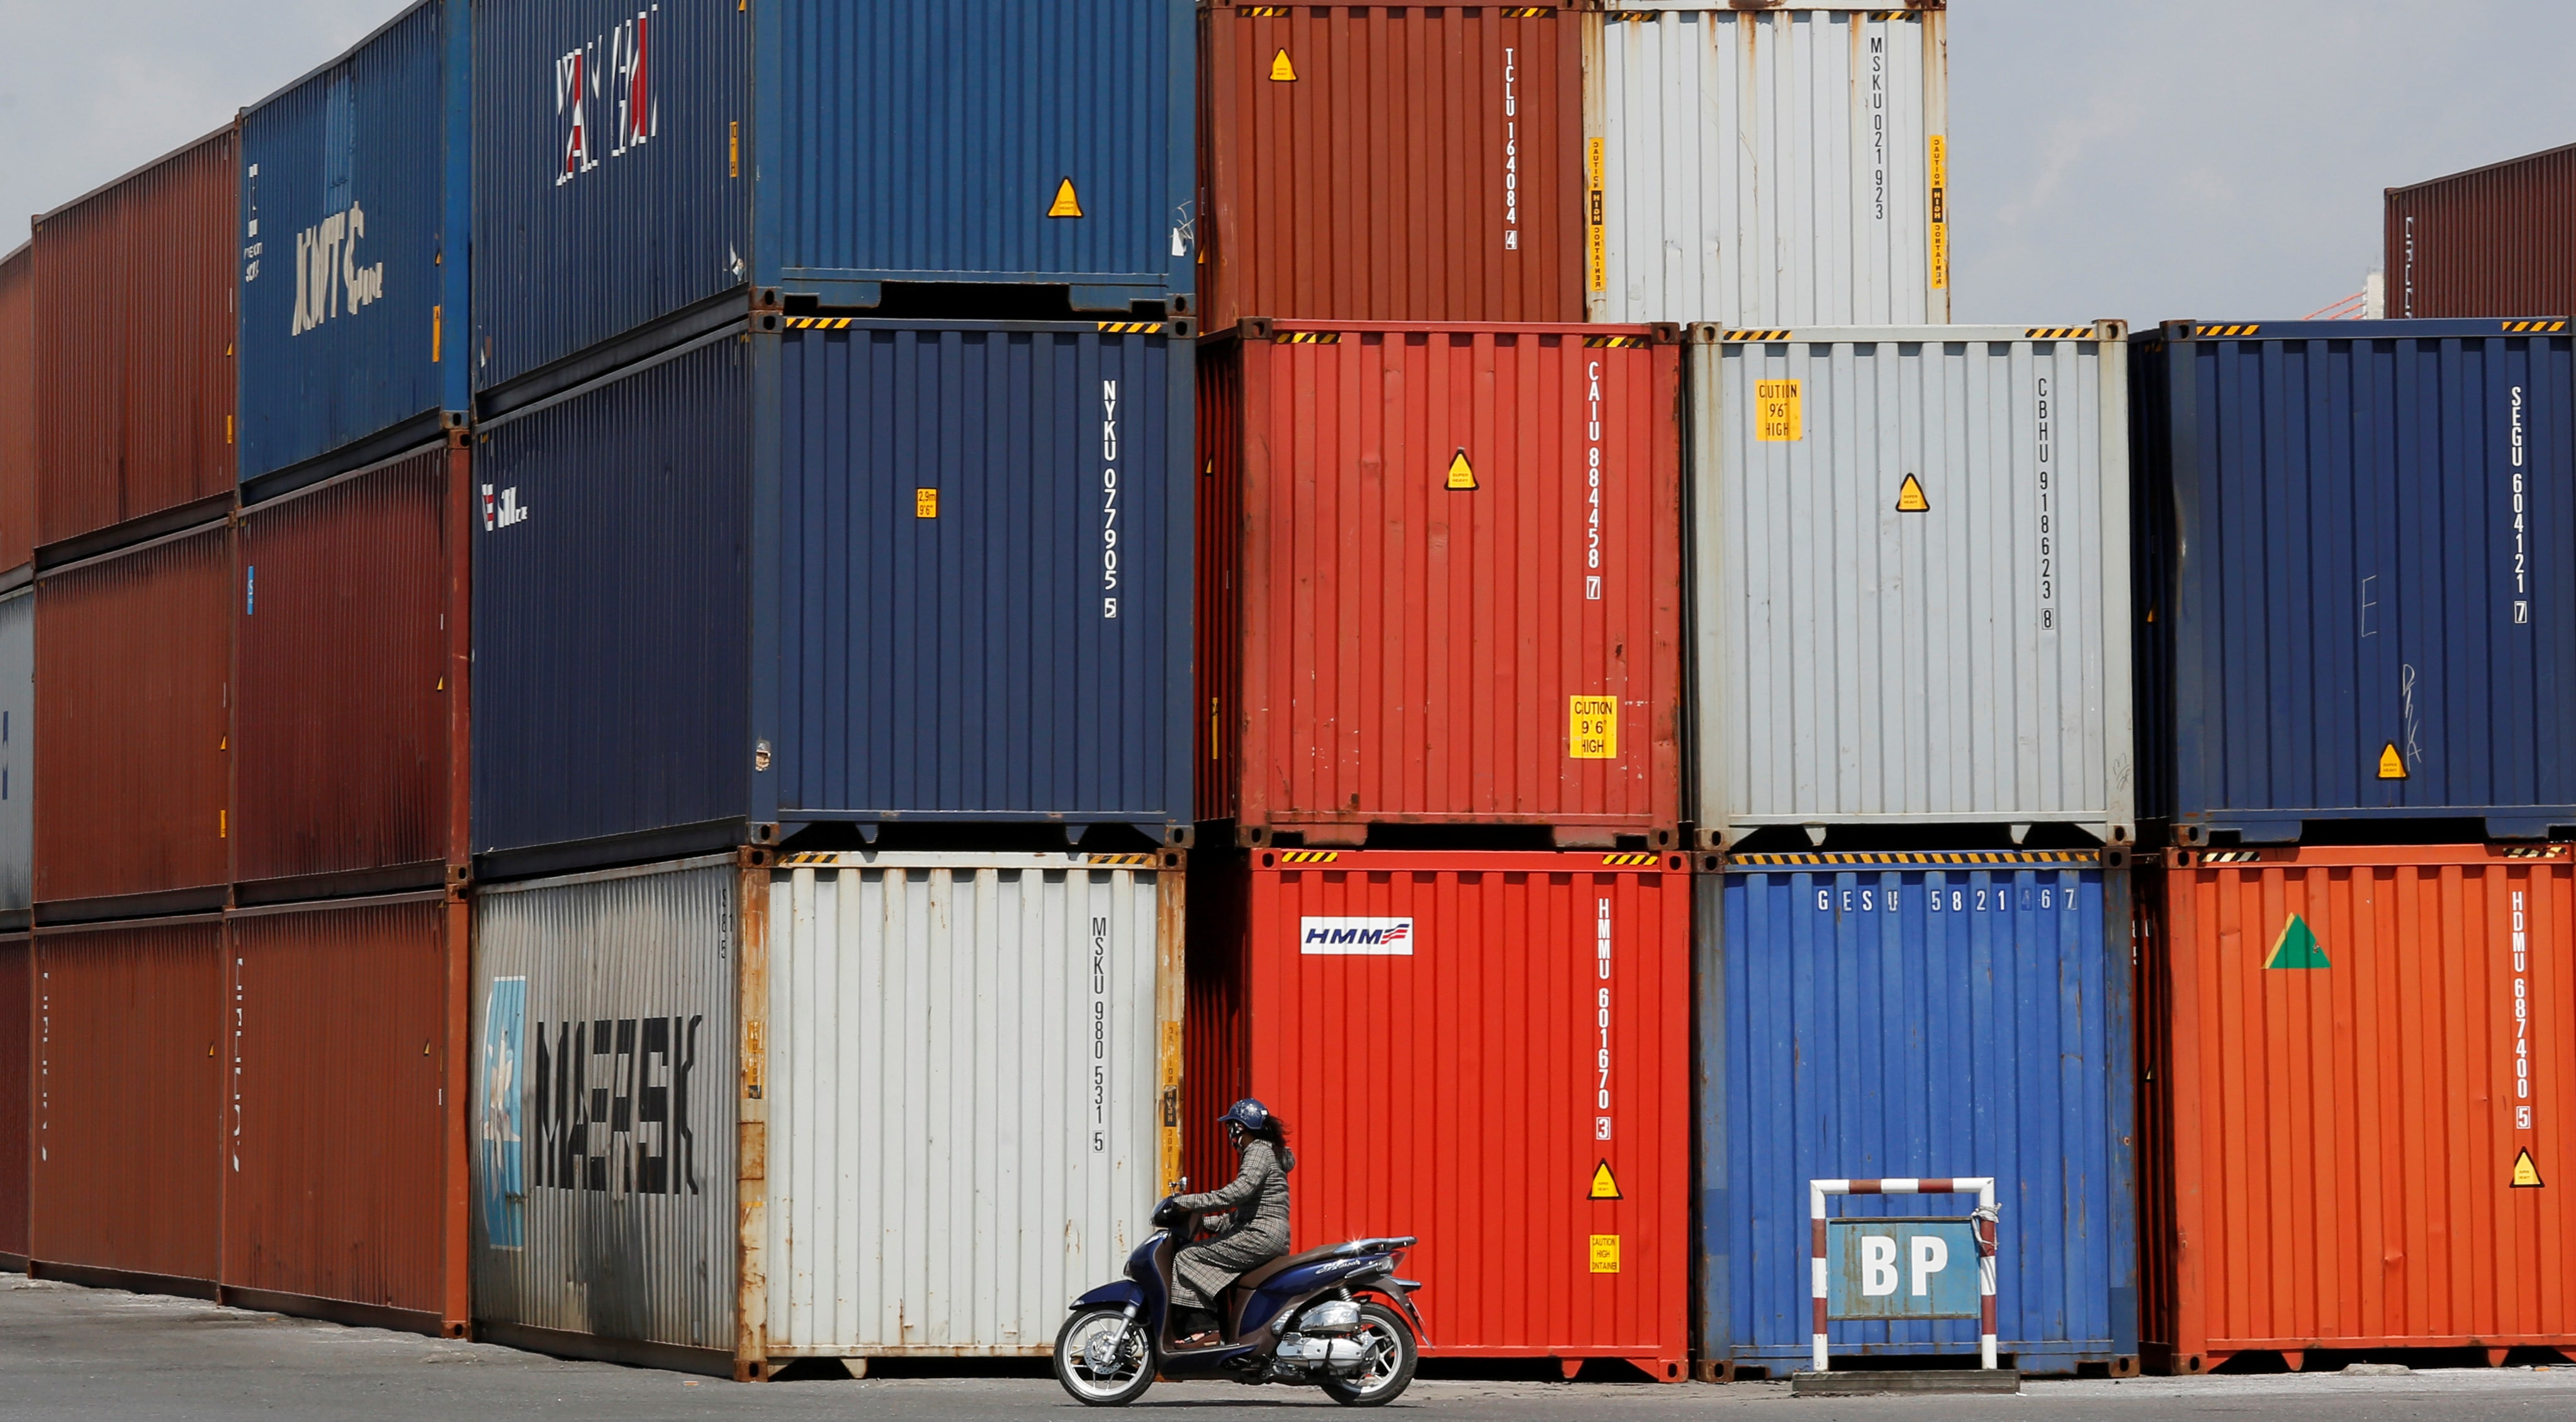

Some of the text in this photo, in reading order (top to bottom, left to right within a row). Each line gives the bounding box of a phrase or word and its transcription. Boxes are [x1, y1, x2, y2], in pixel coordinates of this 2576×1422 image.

[1505, 47, 1517, 249] TCLU 164084 4
[1870, 37, 1884, 220] MSKU 021 923
[1587, 361, 1600, 600] CAIU 884458 7
[1759, 385, 1797, 398] CUTION
[1766, 422, 1789, 436] HIGH
[1103, 380, 1117, 618] NYKU 077905 5
[2037, 378, 2054, 630] CBHU 918623 8
[2511, 386, 2528, 624] SEGU 604121 7
[1575, 701, 1612, 714] CUTION
[1582, 739, 1604, 753] HIGH
[1305, 928, 1383, 944] HMM
[1817, 889, 1898, 912] GESU
[2064, 888, 2077, 911] 7
[1092, 918, 1106, 1153] MSKU 980 531 5
[1596, 898, 1611, 1140] HMMU 601670 3
[2512, 891, 2531, 1129] HDMU 687400 5
[1861, 1235, 1949, 1297] BP
